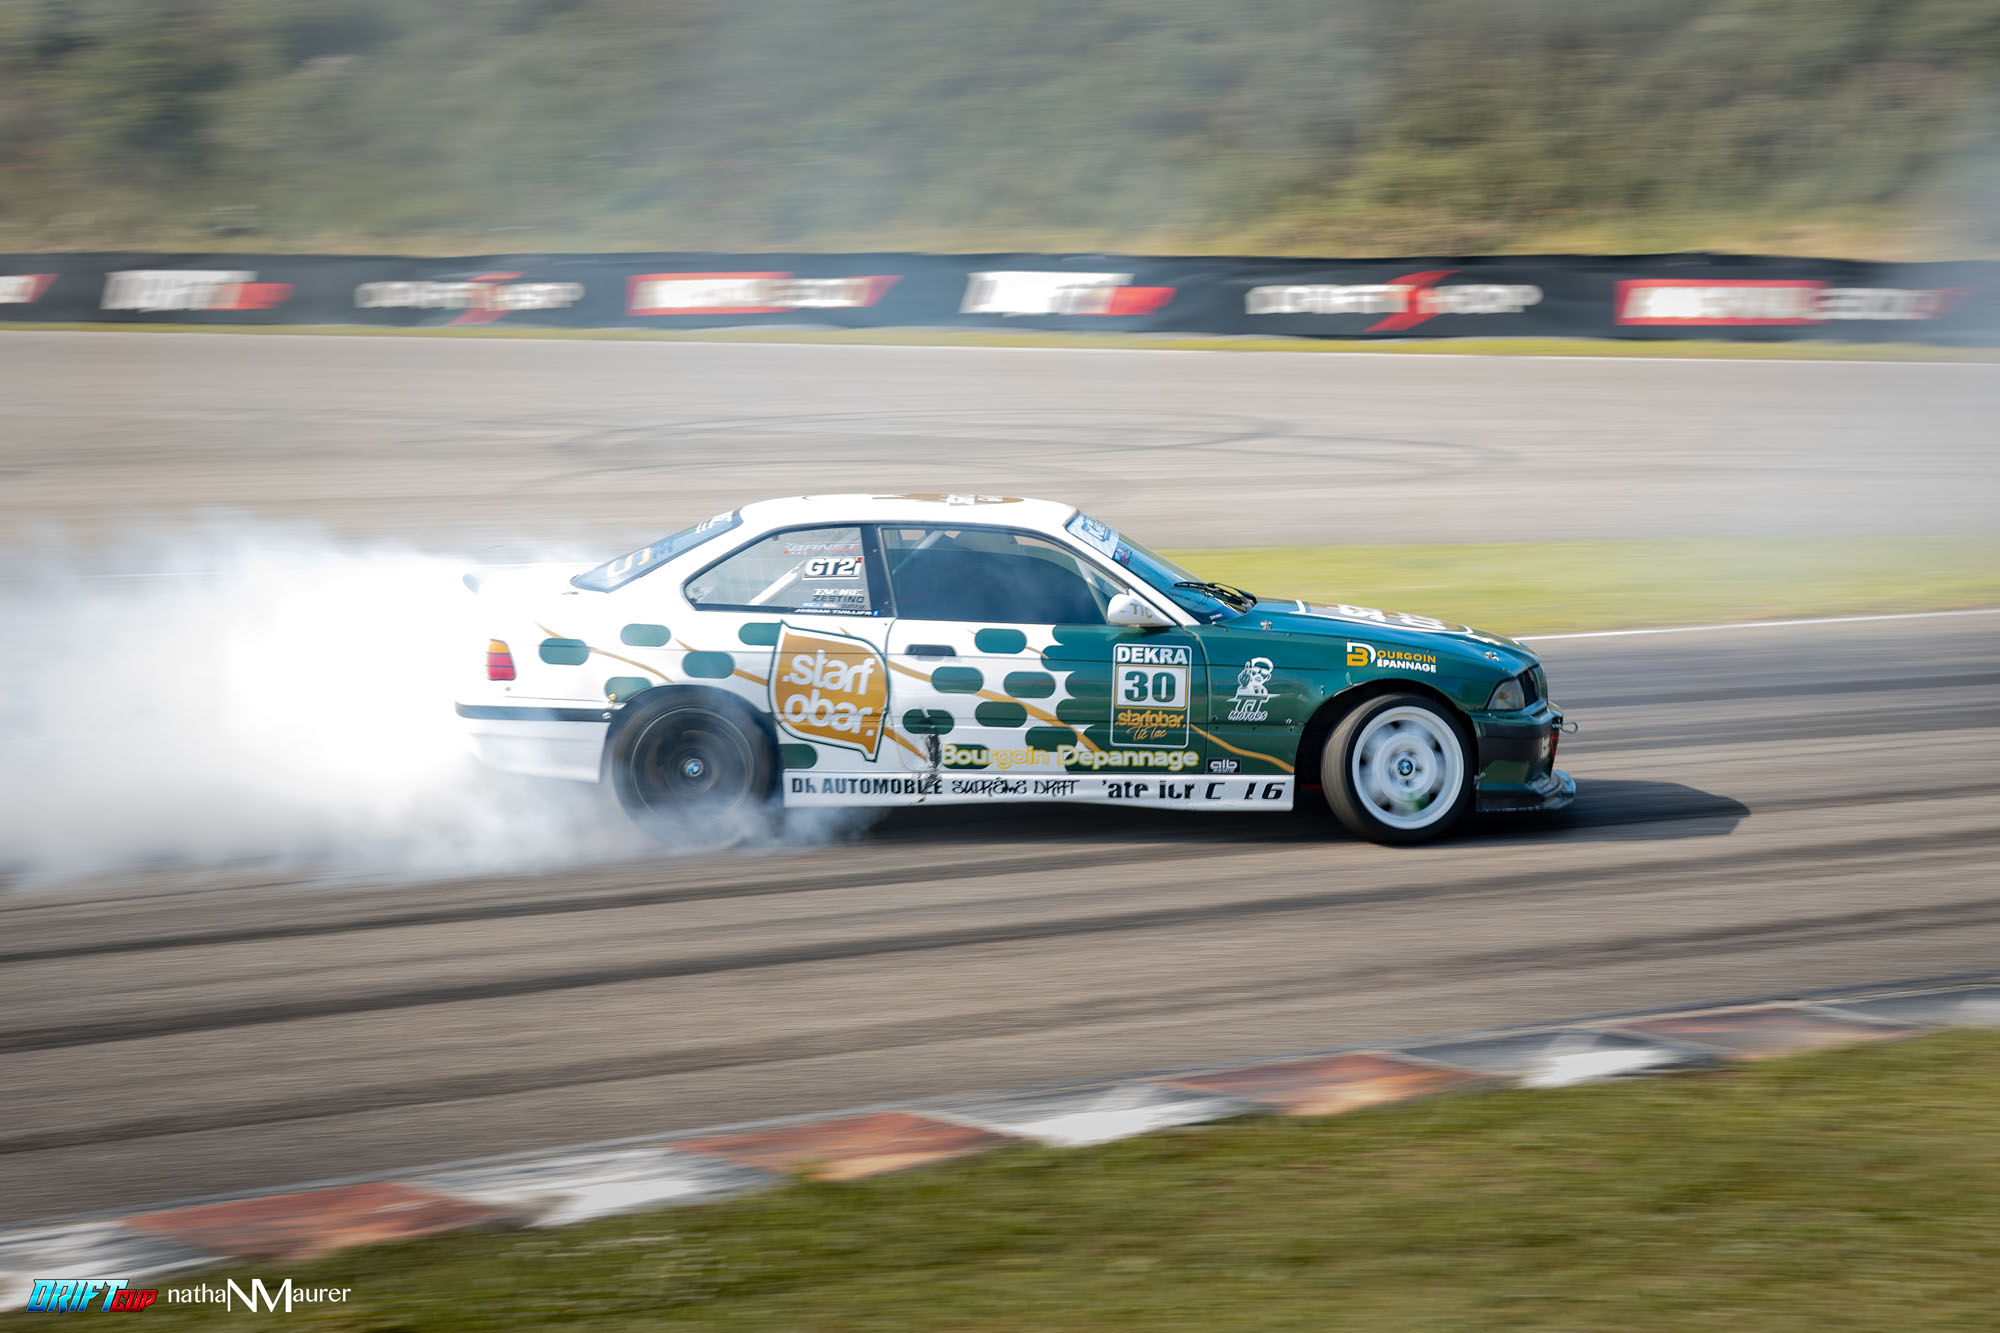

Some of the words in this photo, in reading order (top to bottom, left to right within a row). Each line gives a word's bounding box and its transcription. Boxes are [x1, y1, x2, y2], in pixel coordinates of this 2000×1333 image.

[804, 556, 864, 577] GT2i
[1116, 646, 1188, 665] DEKRA
[1124, 670, 1177, 703] 30
[941, 743, 1051, 770] Bourgoin
